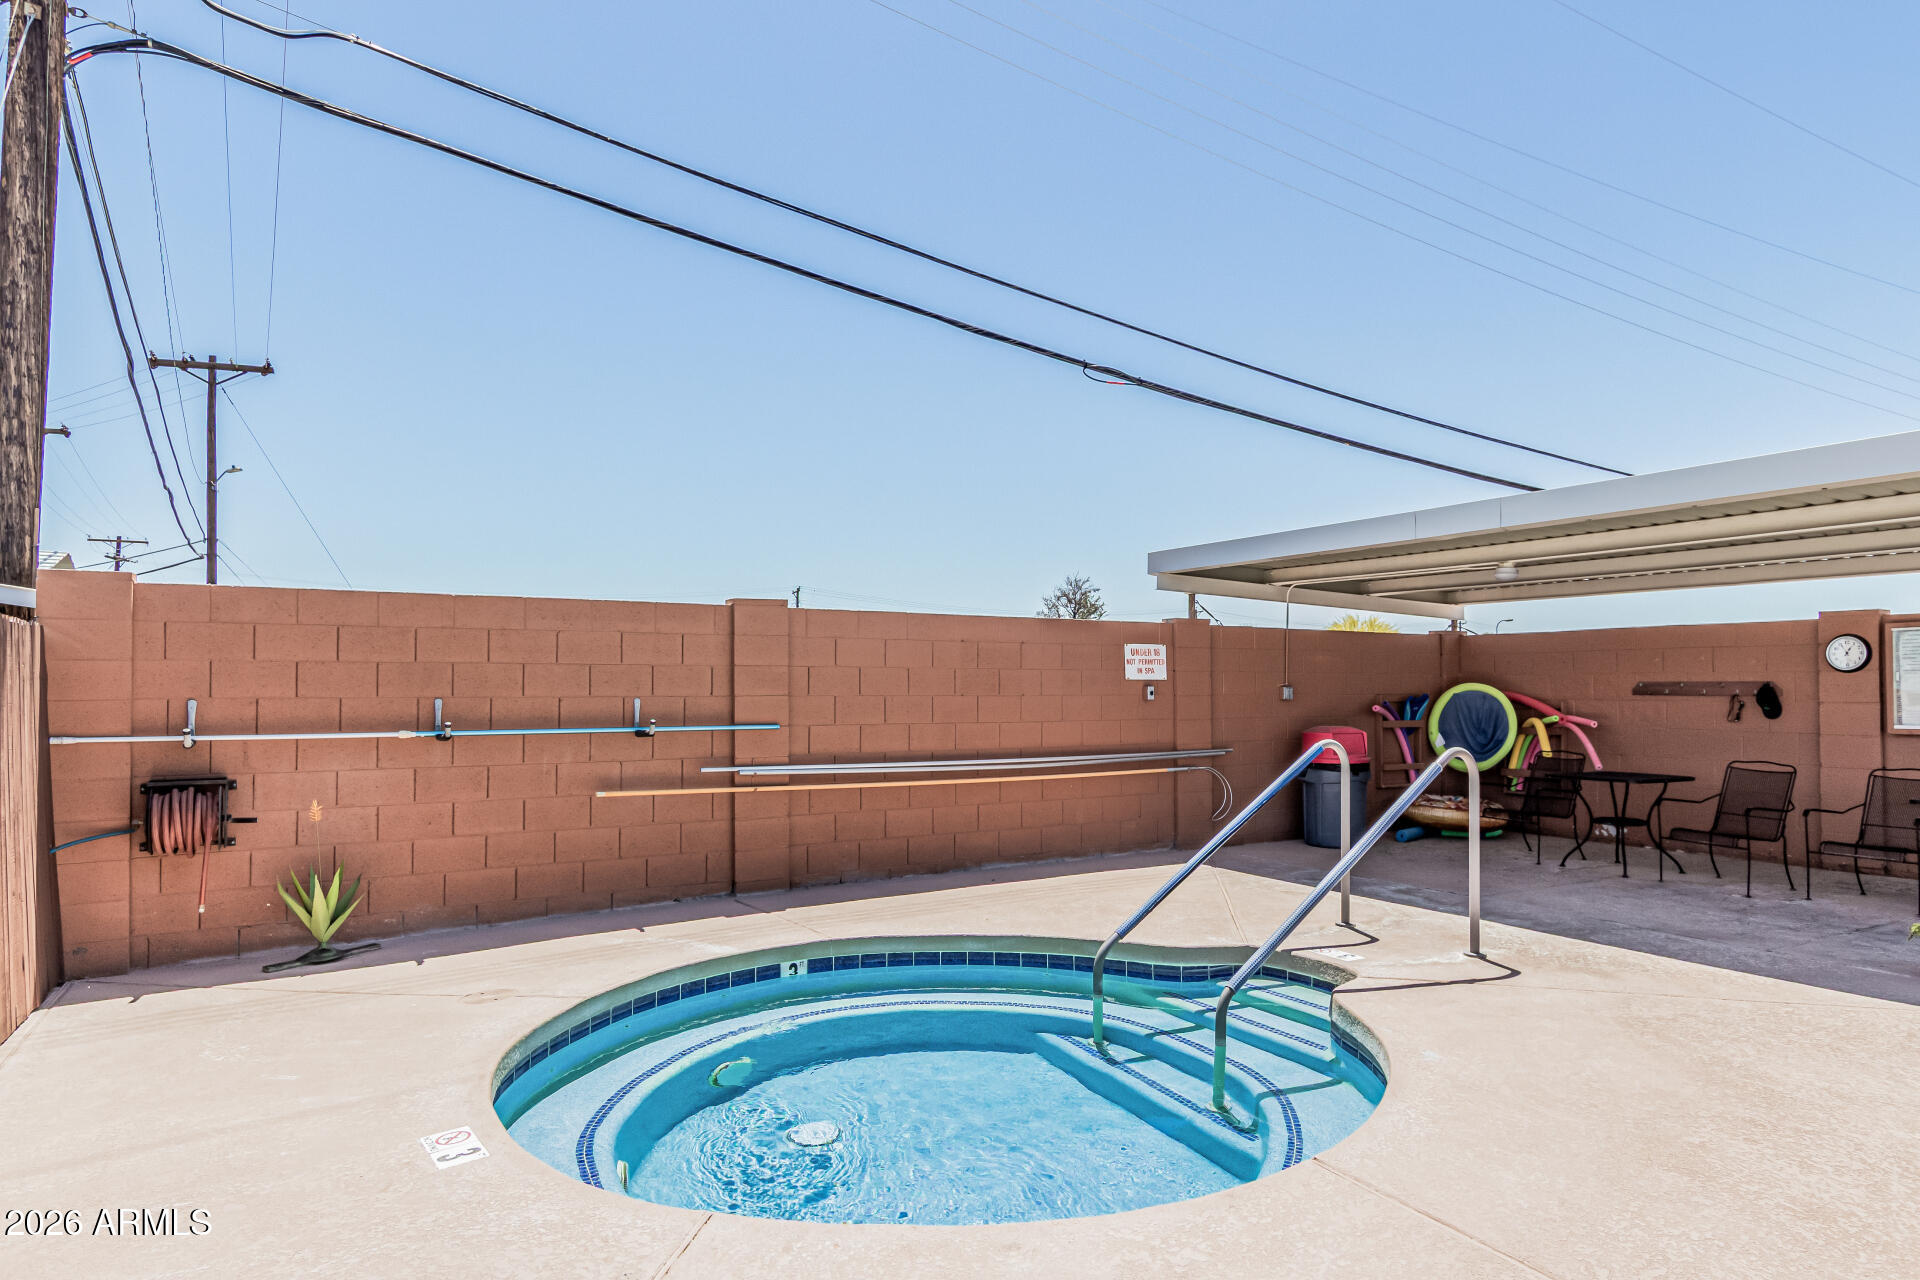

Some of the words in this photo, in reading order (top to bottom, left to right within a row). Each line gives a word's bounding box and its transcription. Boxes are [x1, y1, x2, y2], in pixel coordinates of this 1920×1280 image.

[1130, 648, 1152, 656] UNDER
[1126, 658, 1136, 666] NOT
[1138, 658, 1165, 666] PERMITTED
